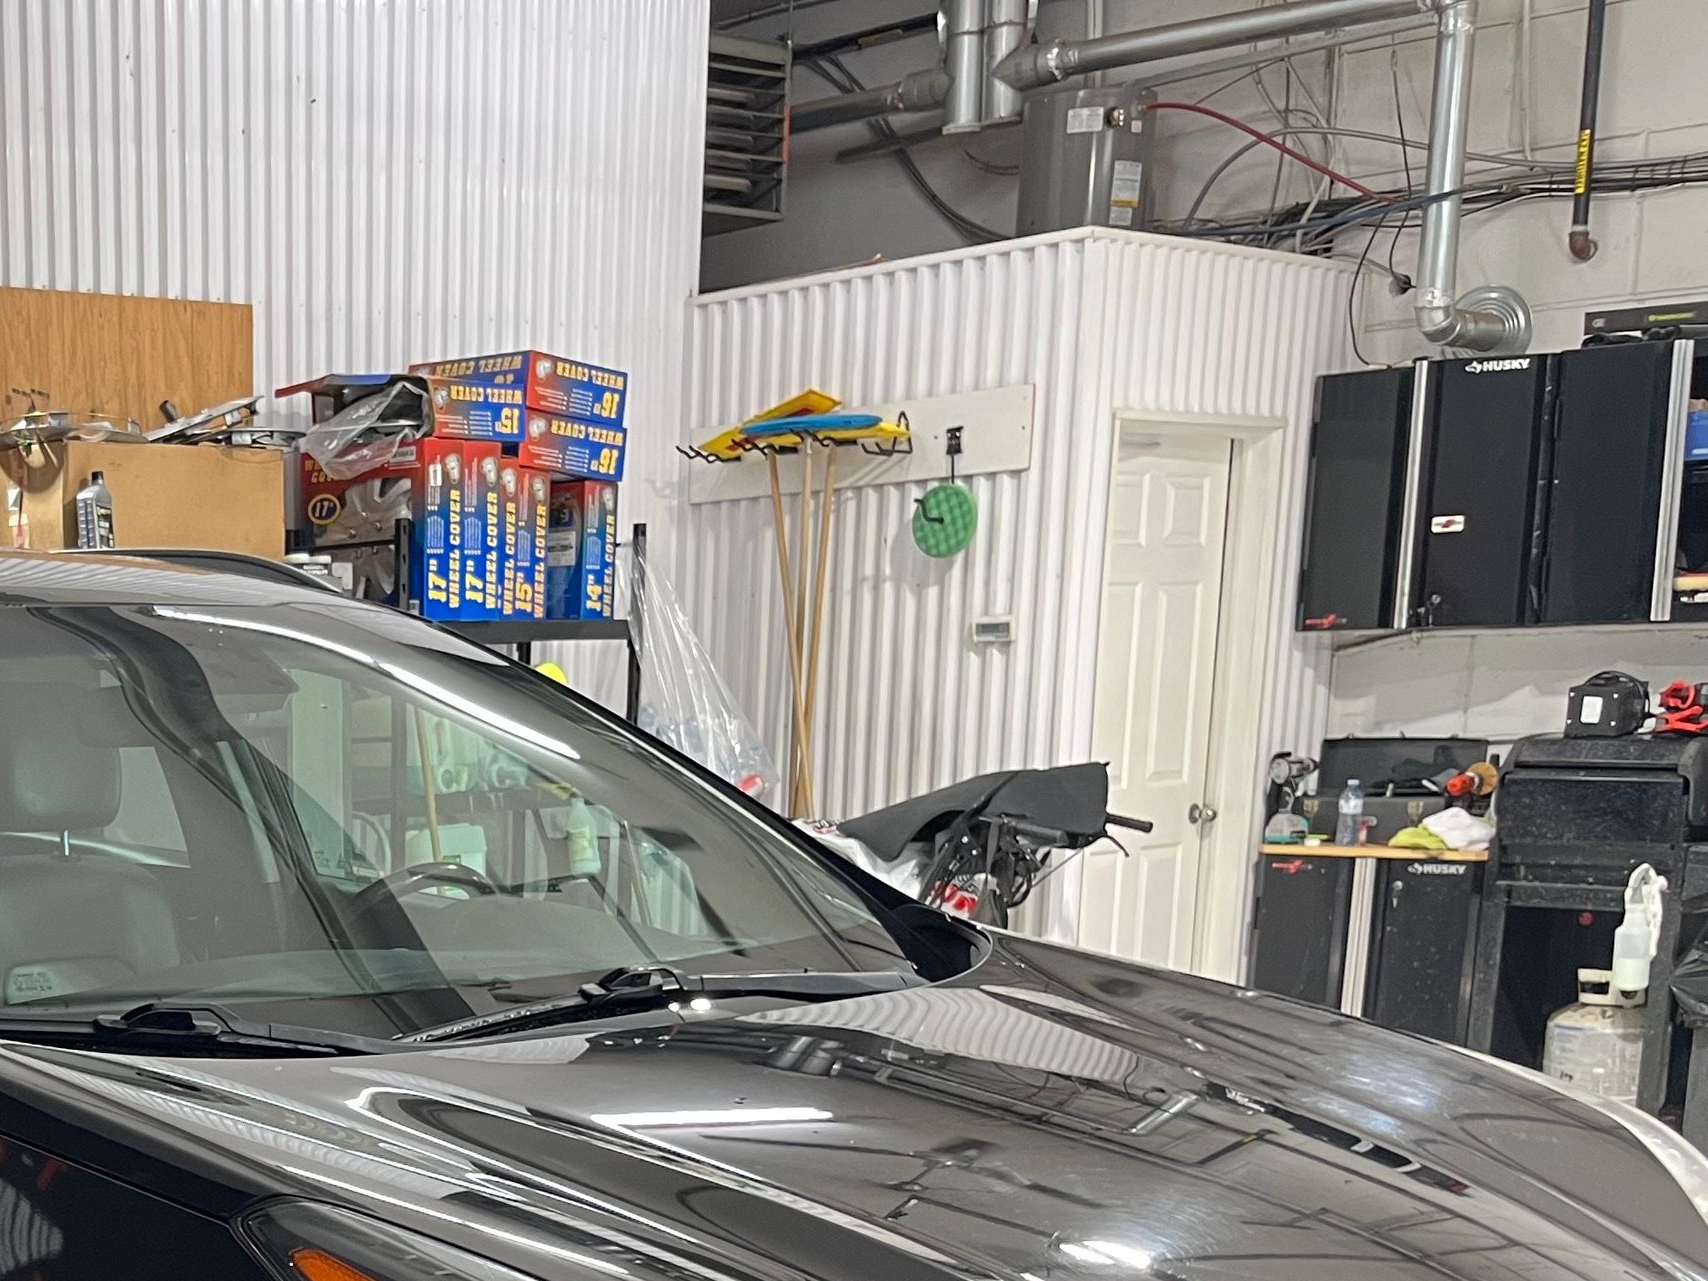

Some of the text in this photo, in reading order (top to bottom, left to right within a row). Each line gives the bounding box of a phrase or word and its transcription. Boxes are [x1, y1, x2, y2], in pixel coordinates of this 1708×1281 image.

[435, 356, 523, 378] WHEEL COVER
[556, 361, 625, 391] WHEEL COVER
[1482, 358, 1531, 372] HUSKY
[450, 385, 485, 402] COVER
[486, 387, 523, 405] WHEEL
[550, 419, 624, 447] WHEEL COVER
[448, 489, 461, 609] WHEEL COVER
[485, 492, 498, 609] WHEEL COVER
[502, 502, 516, 615] WHEEL COVER
[533, 503, 547, 618] WHEEL COVER
[602, 515, 615, 617] WHEEL COVER
[1423, 863, 1467, 875] HUSKY
